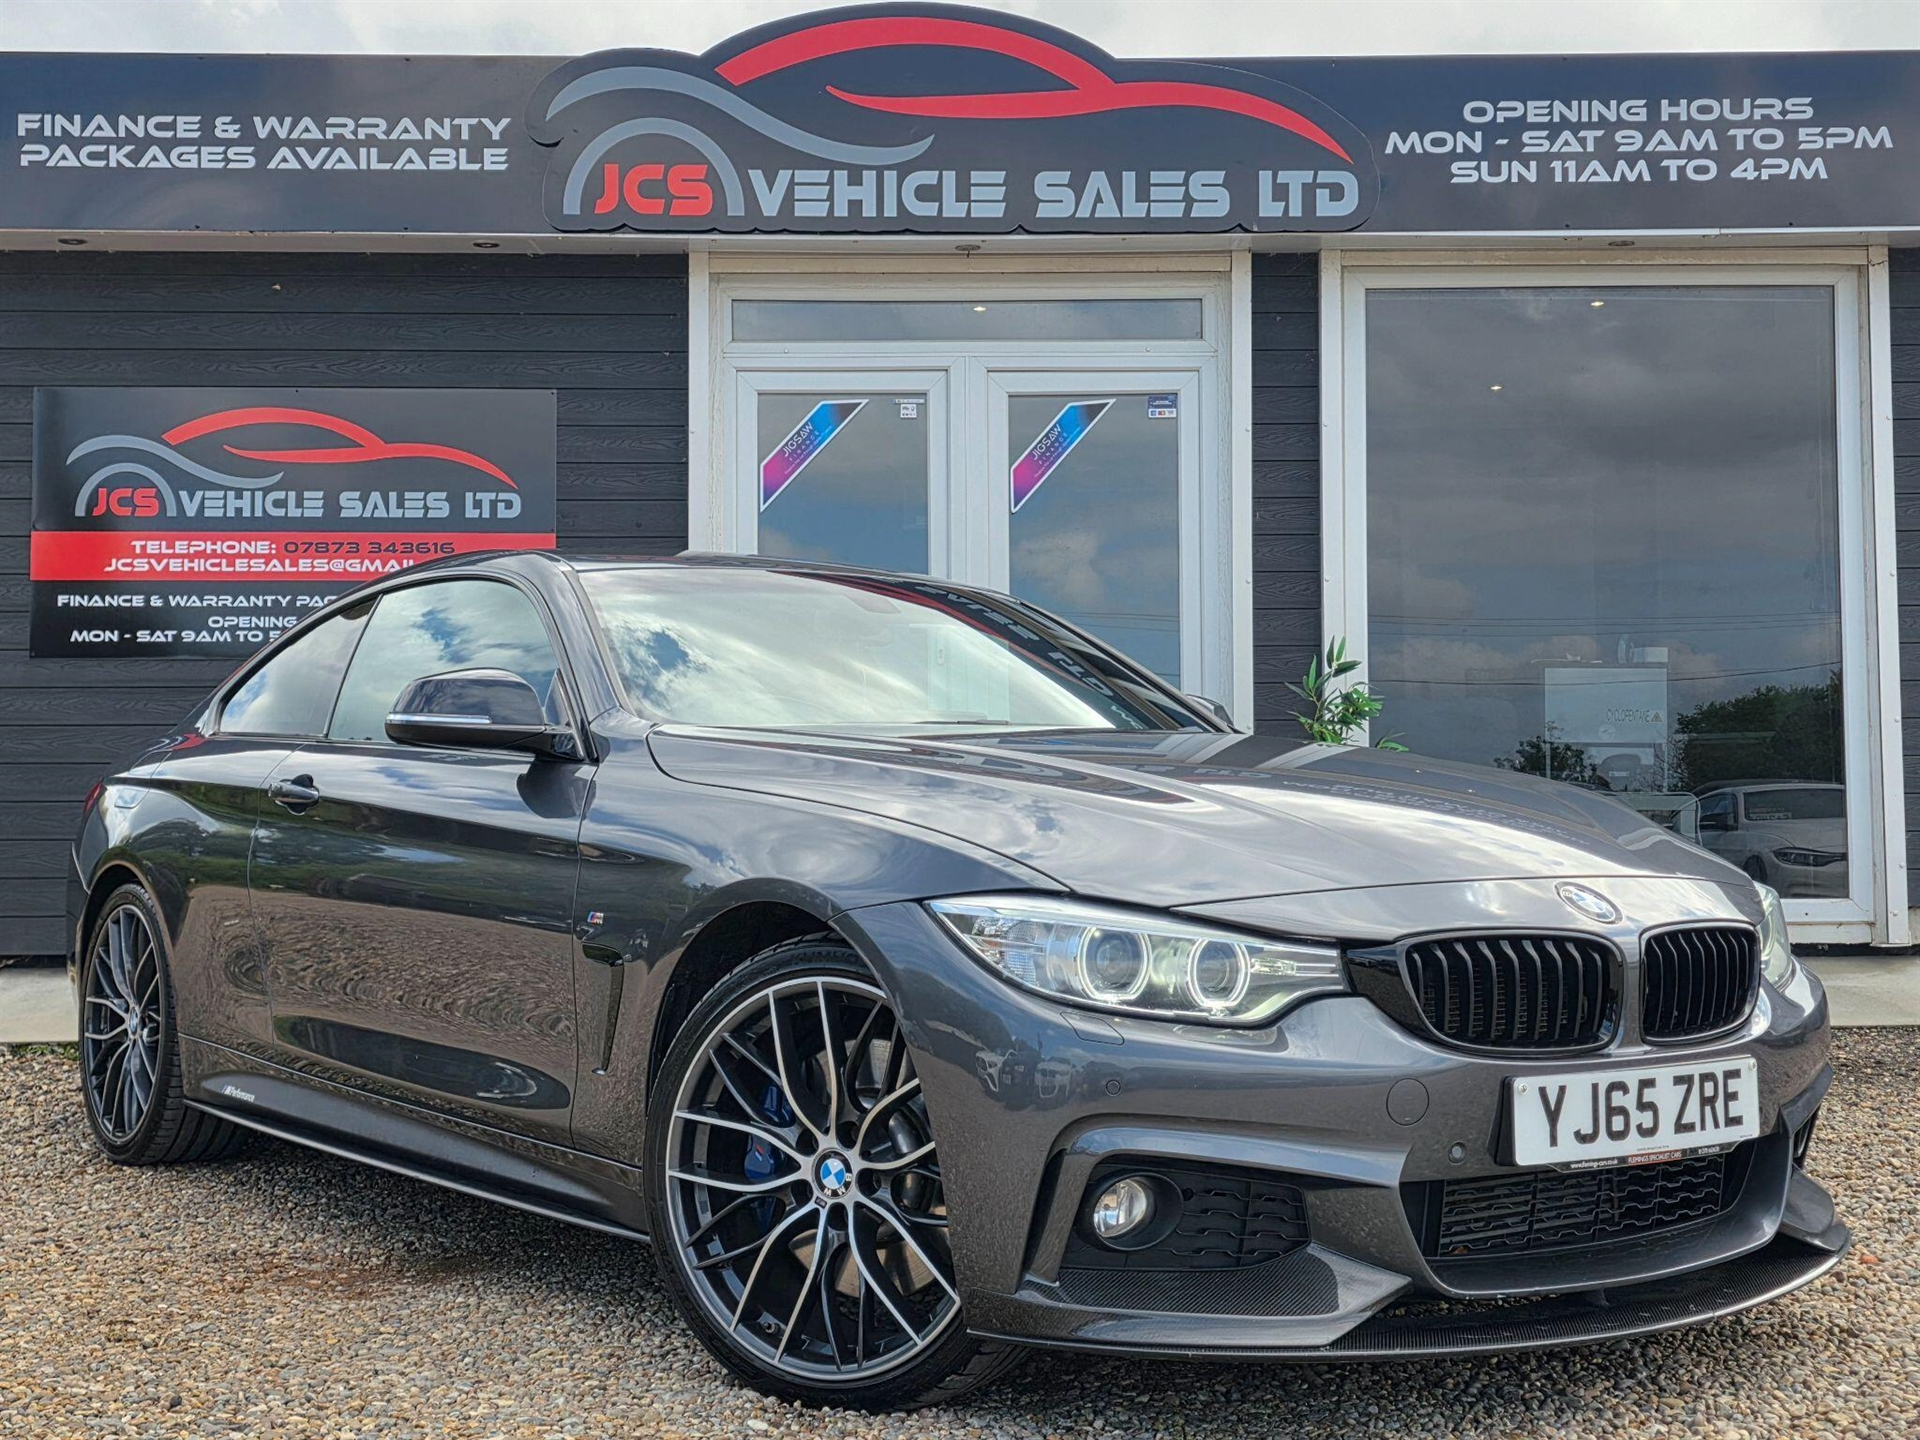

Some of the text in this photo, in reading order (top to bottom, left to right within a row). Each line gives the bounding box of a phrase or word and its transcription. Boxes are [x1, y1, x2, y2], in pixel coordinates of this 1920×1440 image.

[1462, 97, 1814, 124] OPENING HOURS
[17, 113, 512, 141] FINANCE & WARRANTY
[1384, 130, 1483, 155] MON
[1521, 129, 1605, 153] SAT
[1614, 128, 1718, 152] 9AM
[1726, 127, 1785, 151] TO
[1797, 125, 1894, 150] 5PM
[19, 143, 510, 171] PACKAGES AVAILABLE
[1450, 156, 1829, 184] SUN 11AM TO 4PM
[595, 164, 1359, 219] JCS VEHICLE SALES LTD
[782, 421, 813, 458] JIGSAW
[1031, 423, 1062, 461] JIGSAW
[92, 488, 522, 519] JCS VEHICLE SALES LTD
[131, 540, 456, 555] TELEPHONE: 07873 343616
[57, 595, 145, 607] FINANCE
[150, 595, 163, 607] &
[168, 595, 292, 608] WARRANTY
[70, 630, 119, 643] MON
[136, 630, 177, 643] SAT
[181, 631, 231, 643] 9AM
[235, 630, 263, 643] TO
[207, 616, 298, 629] OPENING
[1538, 1068, 1744, 1148] YJ65 ZRE
